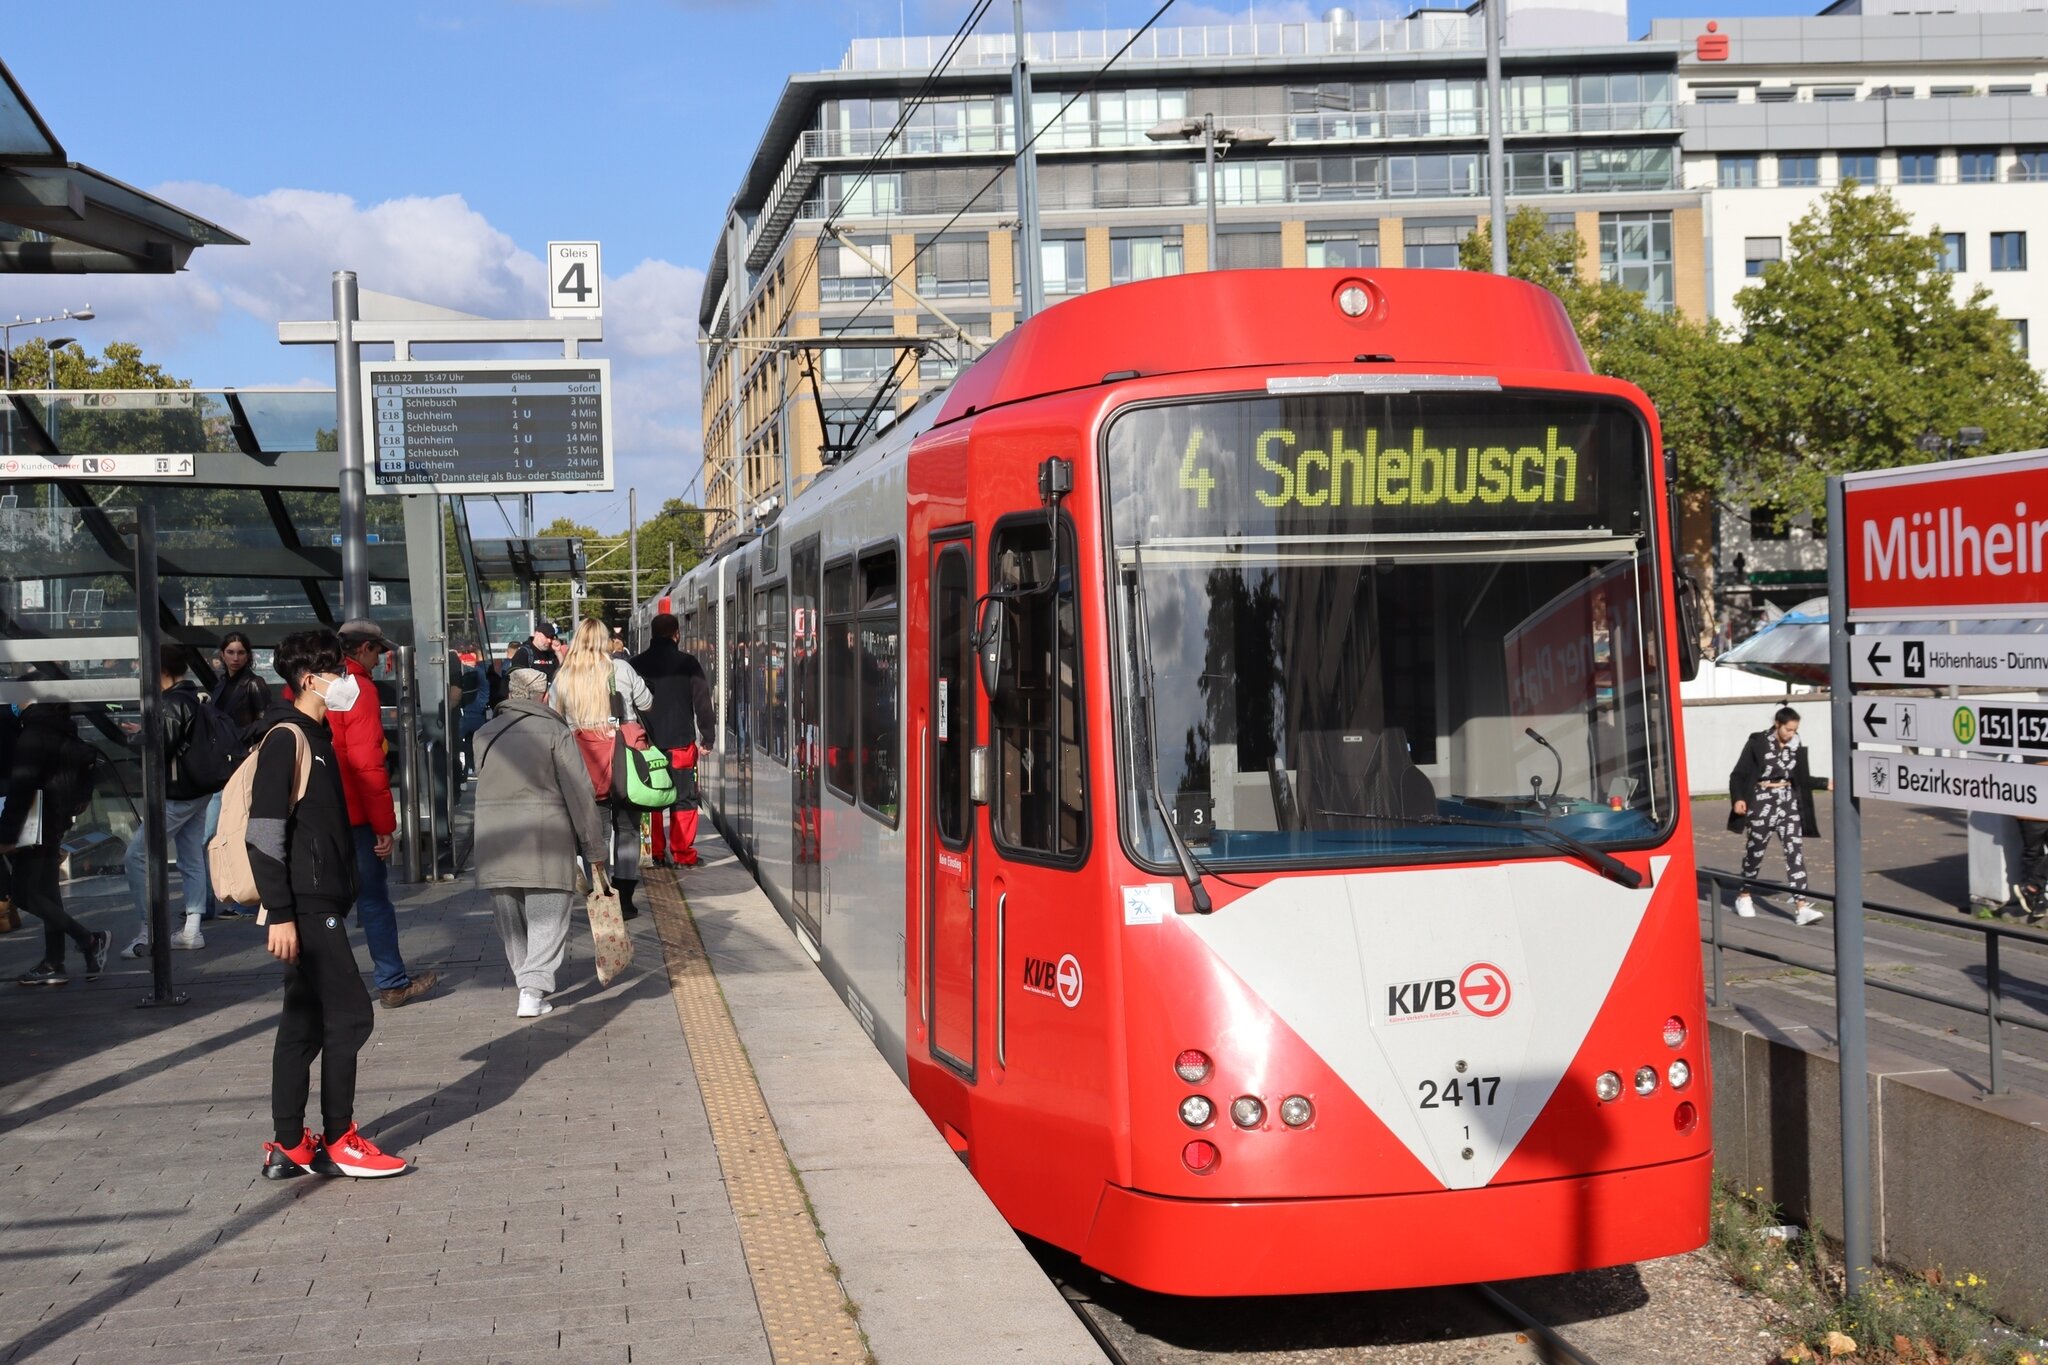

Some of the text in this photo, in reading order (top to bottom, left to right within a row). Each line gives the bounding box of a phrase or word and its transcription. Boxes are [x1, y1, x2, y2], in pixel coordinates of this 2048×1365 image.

[560, 247, 588, 258] Gleis
[558, 262, 592, 303] 4
[377, 371, 596, 382] 11.10.22 15:47 Uhr Gleis in
[386, 383, 596, 395] 4 Schlebusch 4 Sofort
[387, 396, 597, 408] 4 Schlebusch 4 3 Min
[382, 411, 400, 420] E18
[406, 410, 453, 420] Buchheim
[513, 410, 518, 418] 1
[571, 409, 577, 418] 4
[580, 408, 597, 417] Min
[388, 420, 597, 433] 4 Schlebusch 4 9 Min
[383, 436, 400, 445] E18
[407, 435, 454, 445] Buchheim
[514, 435, 518, 443] 1
[567, 433, 577, 442] 14
[580, 432, 598, 442] Min
[389, 445, 598, 458] 4 Schlebusch 4 15 Min
[384, 462, 402, 470] E18
[409, 460, 455, 470] Buchheim
[515, 459, 519, 468] 1
[567, 458, 578, 467] 24
[581, 457, 599, 467] Min
[1178, 425, 1578, 508] 4 Schlebusch
[404, 472, 439, 483] halten?
[441, 473, 466, 482] Dann
[467, 472, 490, 483] steig
[491, 471, 504, 481] als
[506, 471, 526, 481] Bus-
[527, 470, 549, 480] oder
[374, 590, 382, 602] 3
[576, 585, 584, 596] 4
[1907, 646, 1921, 673] 4
[1929, 652, 1998, 669] Höhenhaus
[1980, 715, 2012, 740] 151
[2018, 716, 2048, 742] 152
[1897, 765, 2037, 805] Bezirksrathaus
[1171, 808, 1203, 825] 1 3
[1024, 957, 1056, 990] KVB
[1388, 979, 1456, 1016] KVB
[1418, 1076, 1501, 1109] 2417
[1463, 1125, 1470, 1140] 1
